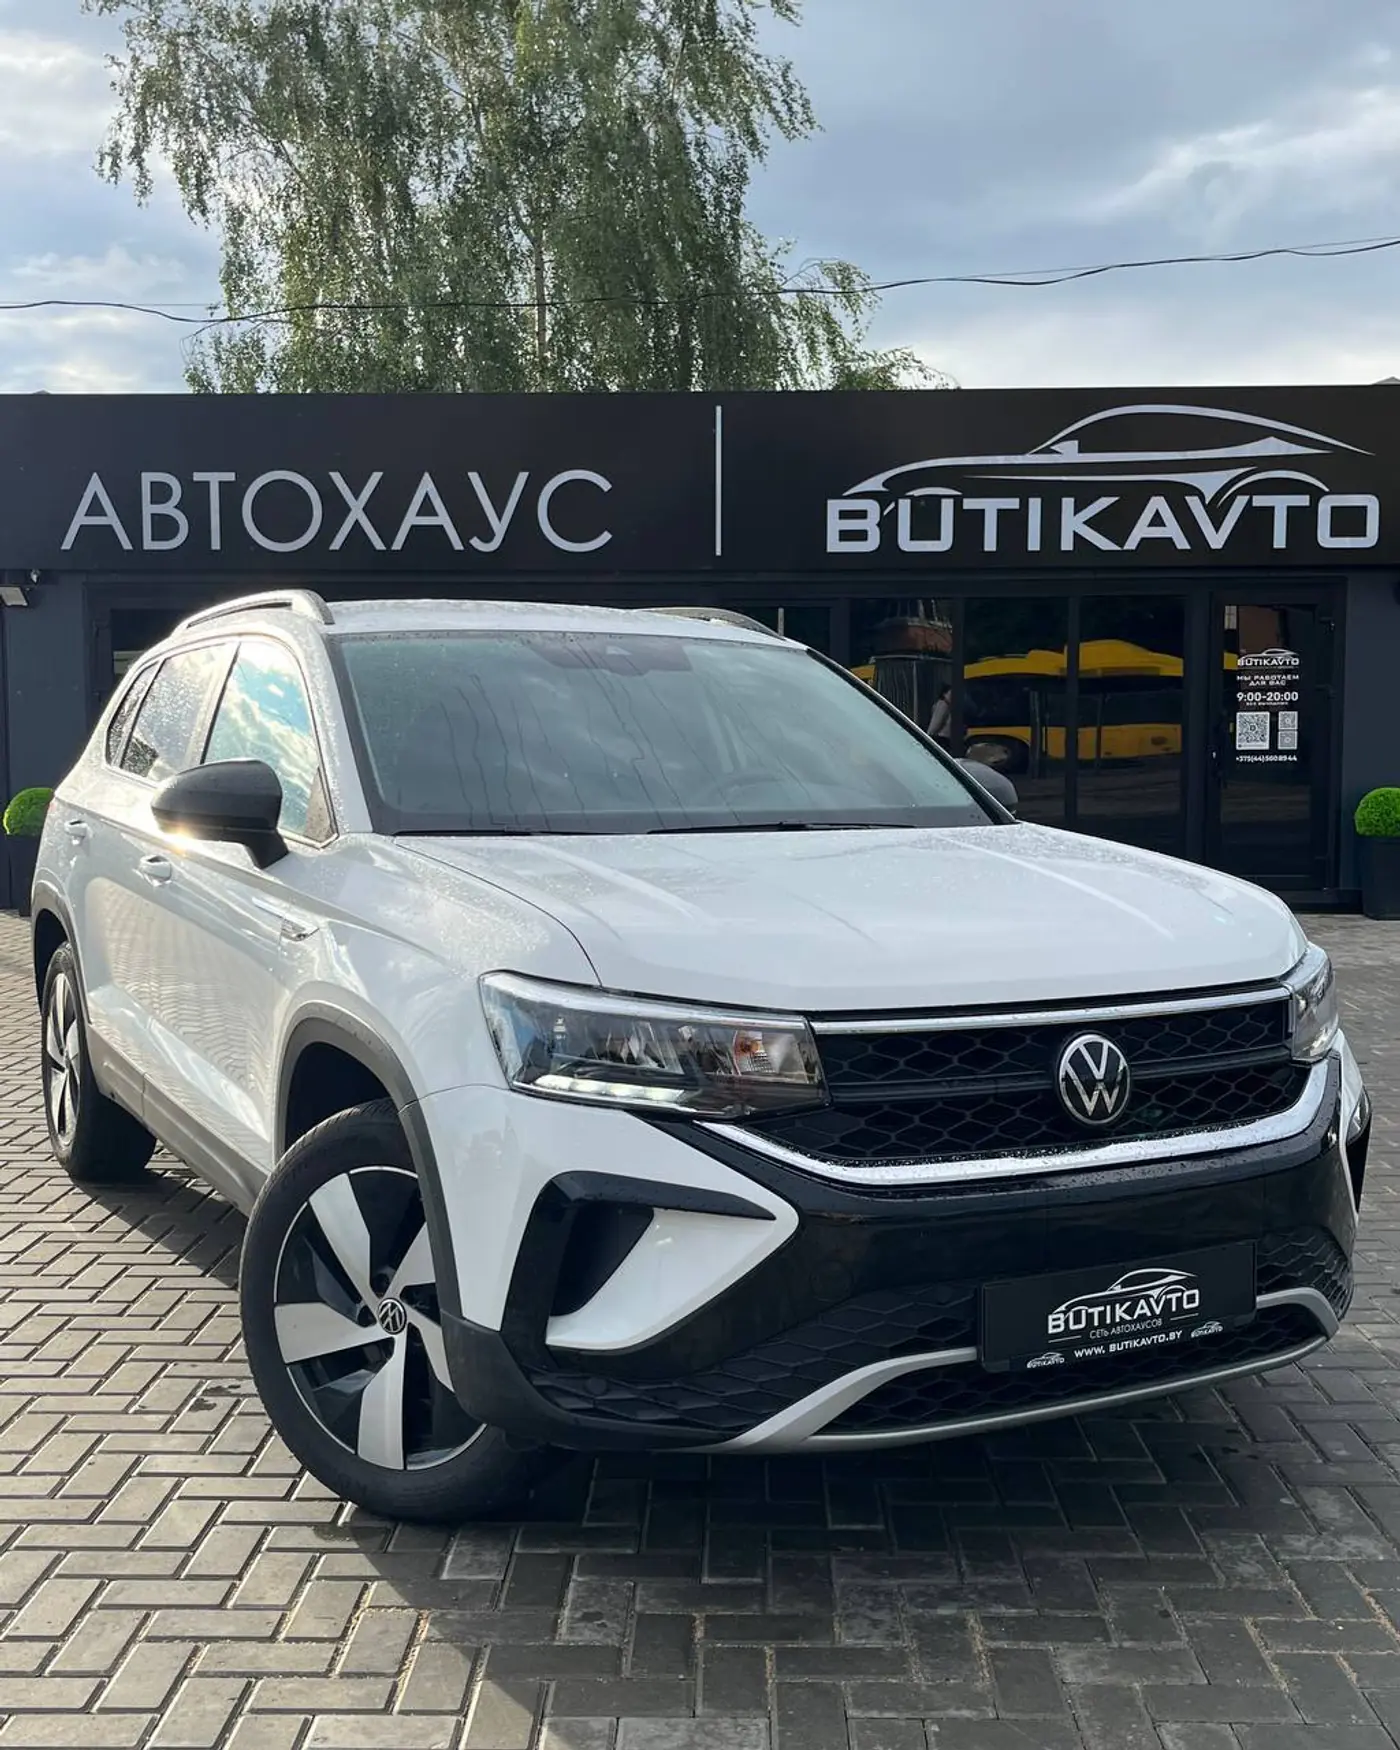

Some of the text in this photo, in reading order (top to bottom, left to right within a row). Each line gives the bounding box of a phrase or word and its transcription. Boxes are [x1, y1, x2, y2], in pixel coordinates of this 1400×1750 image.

[61, 469, 612, 553] АВТОХАУС
[826, 492, 1380, 553] BUTIKAVTO
[1236, 692, 1299, 702] 9:00-20:00
[1047, 1288, 1200, 1335] BUTIKAVTO
[1109, 1330, 1183, 1352] BUTIKAVTO.BY
